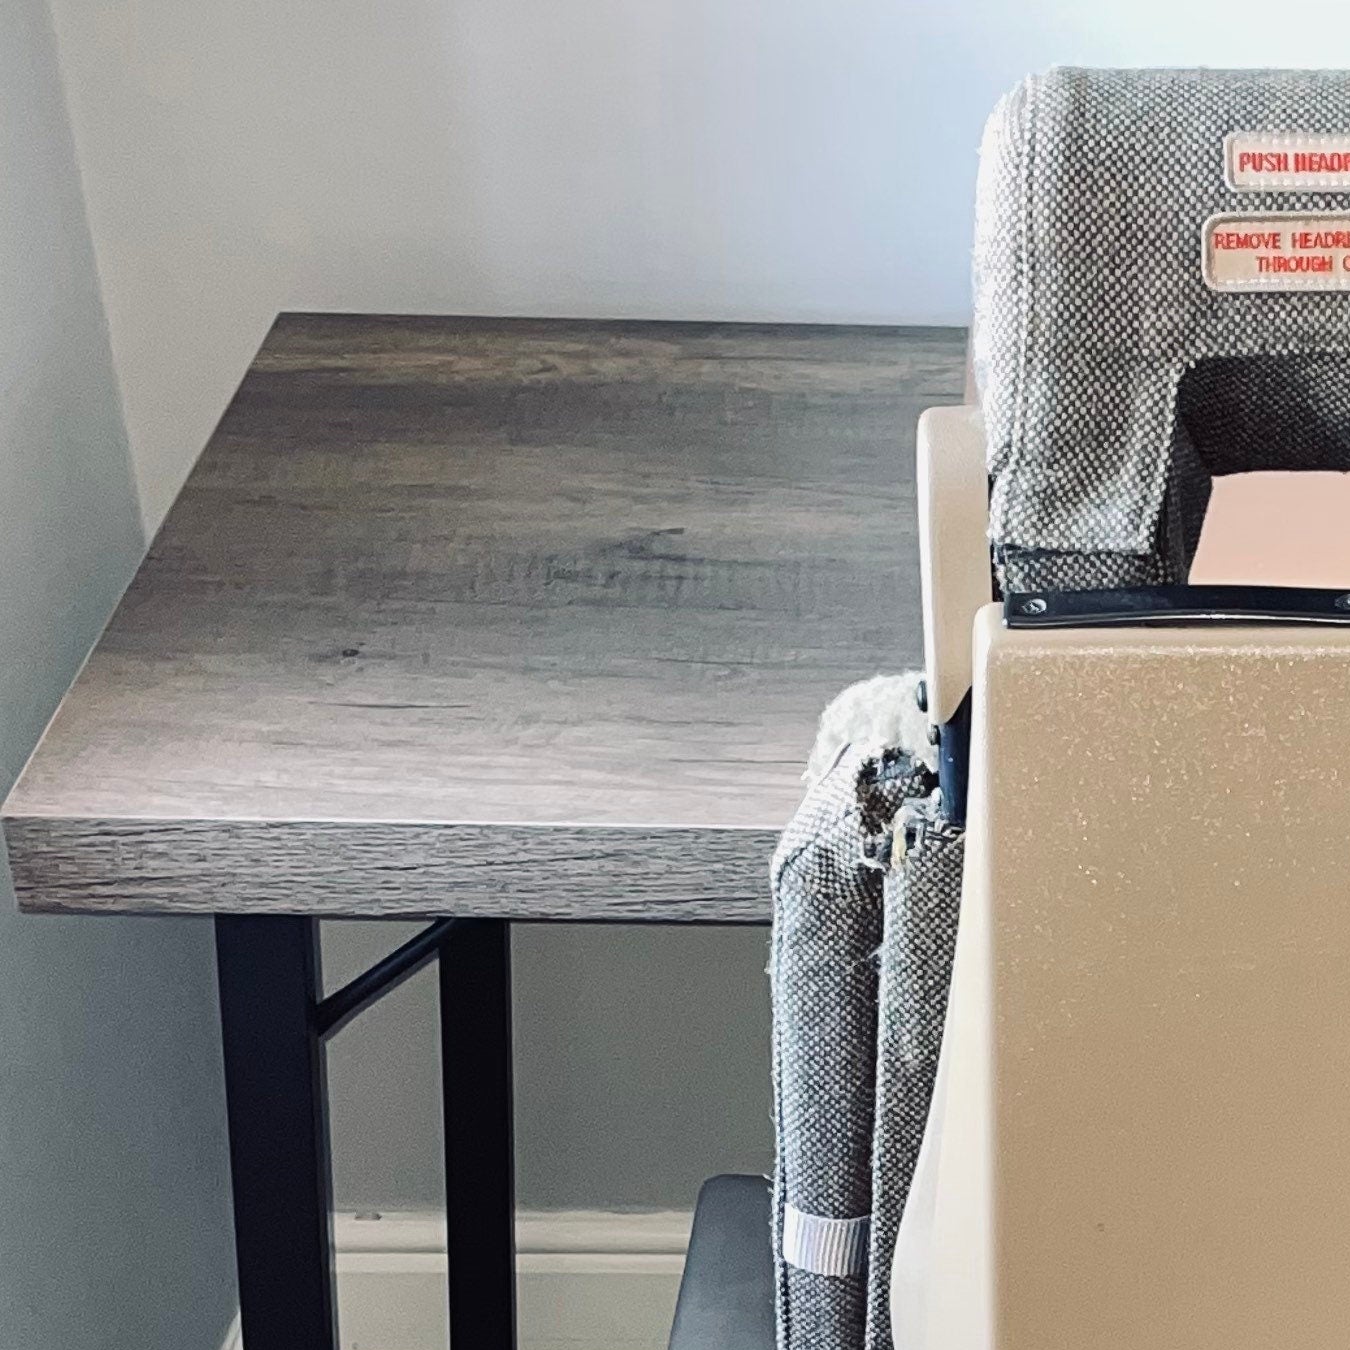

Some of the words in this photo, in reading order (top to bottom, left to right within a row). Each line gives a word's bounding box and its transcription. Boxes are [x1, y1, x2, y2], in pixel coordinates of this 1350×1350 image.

[1238, 151, 1290, 173] PUSH
[1212, 231, 1282, 251] REMOVE
[1255, 254, 1334, 274] THROUGH
